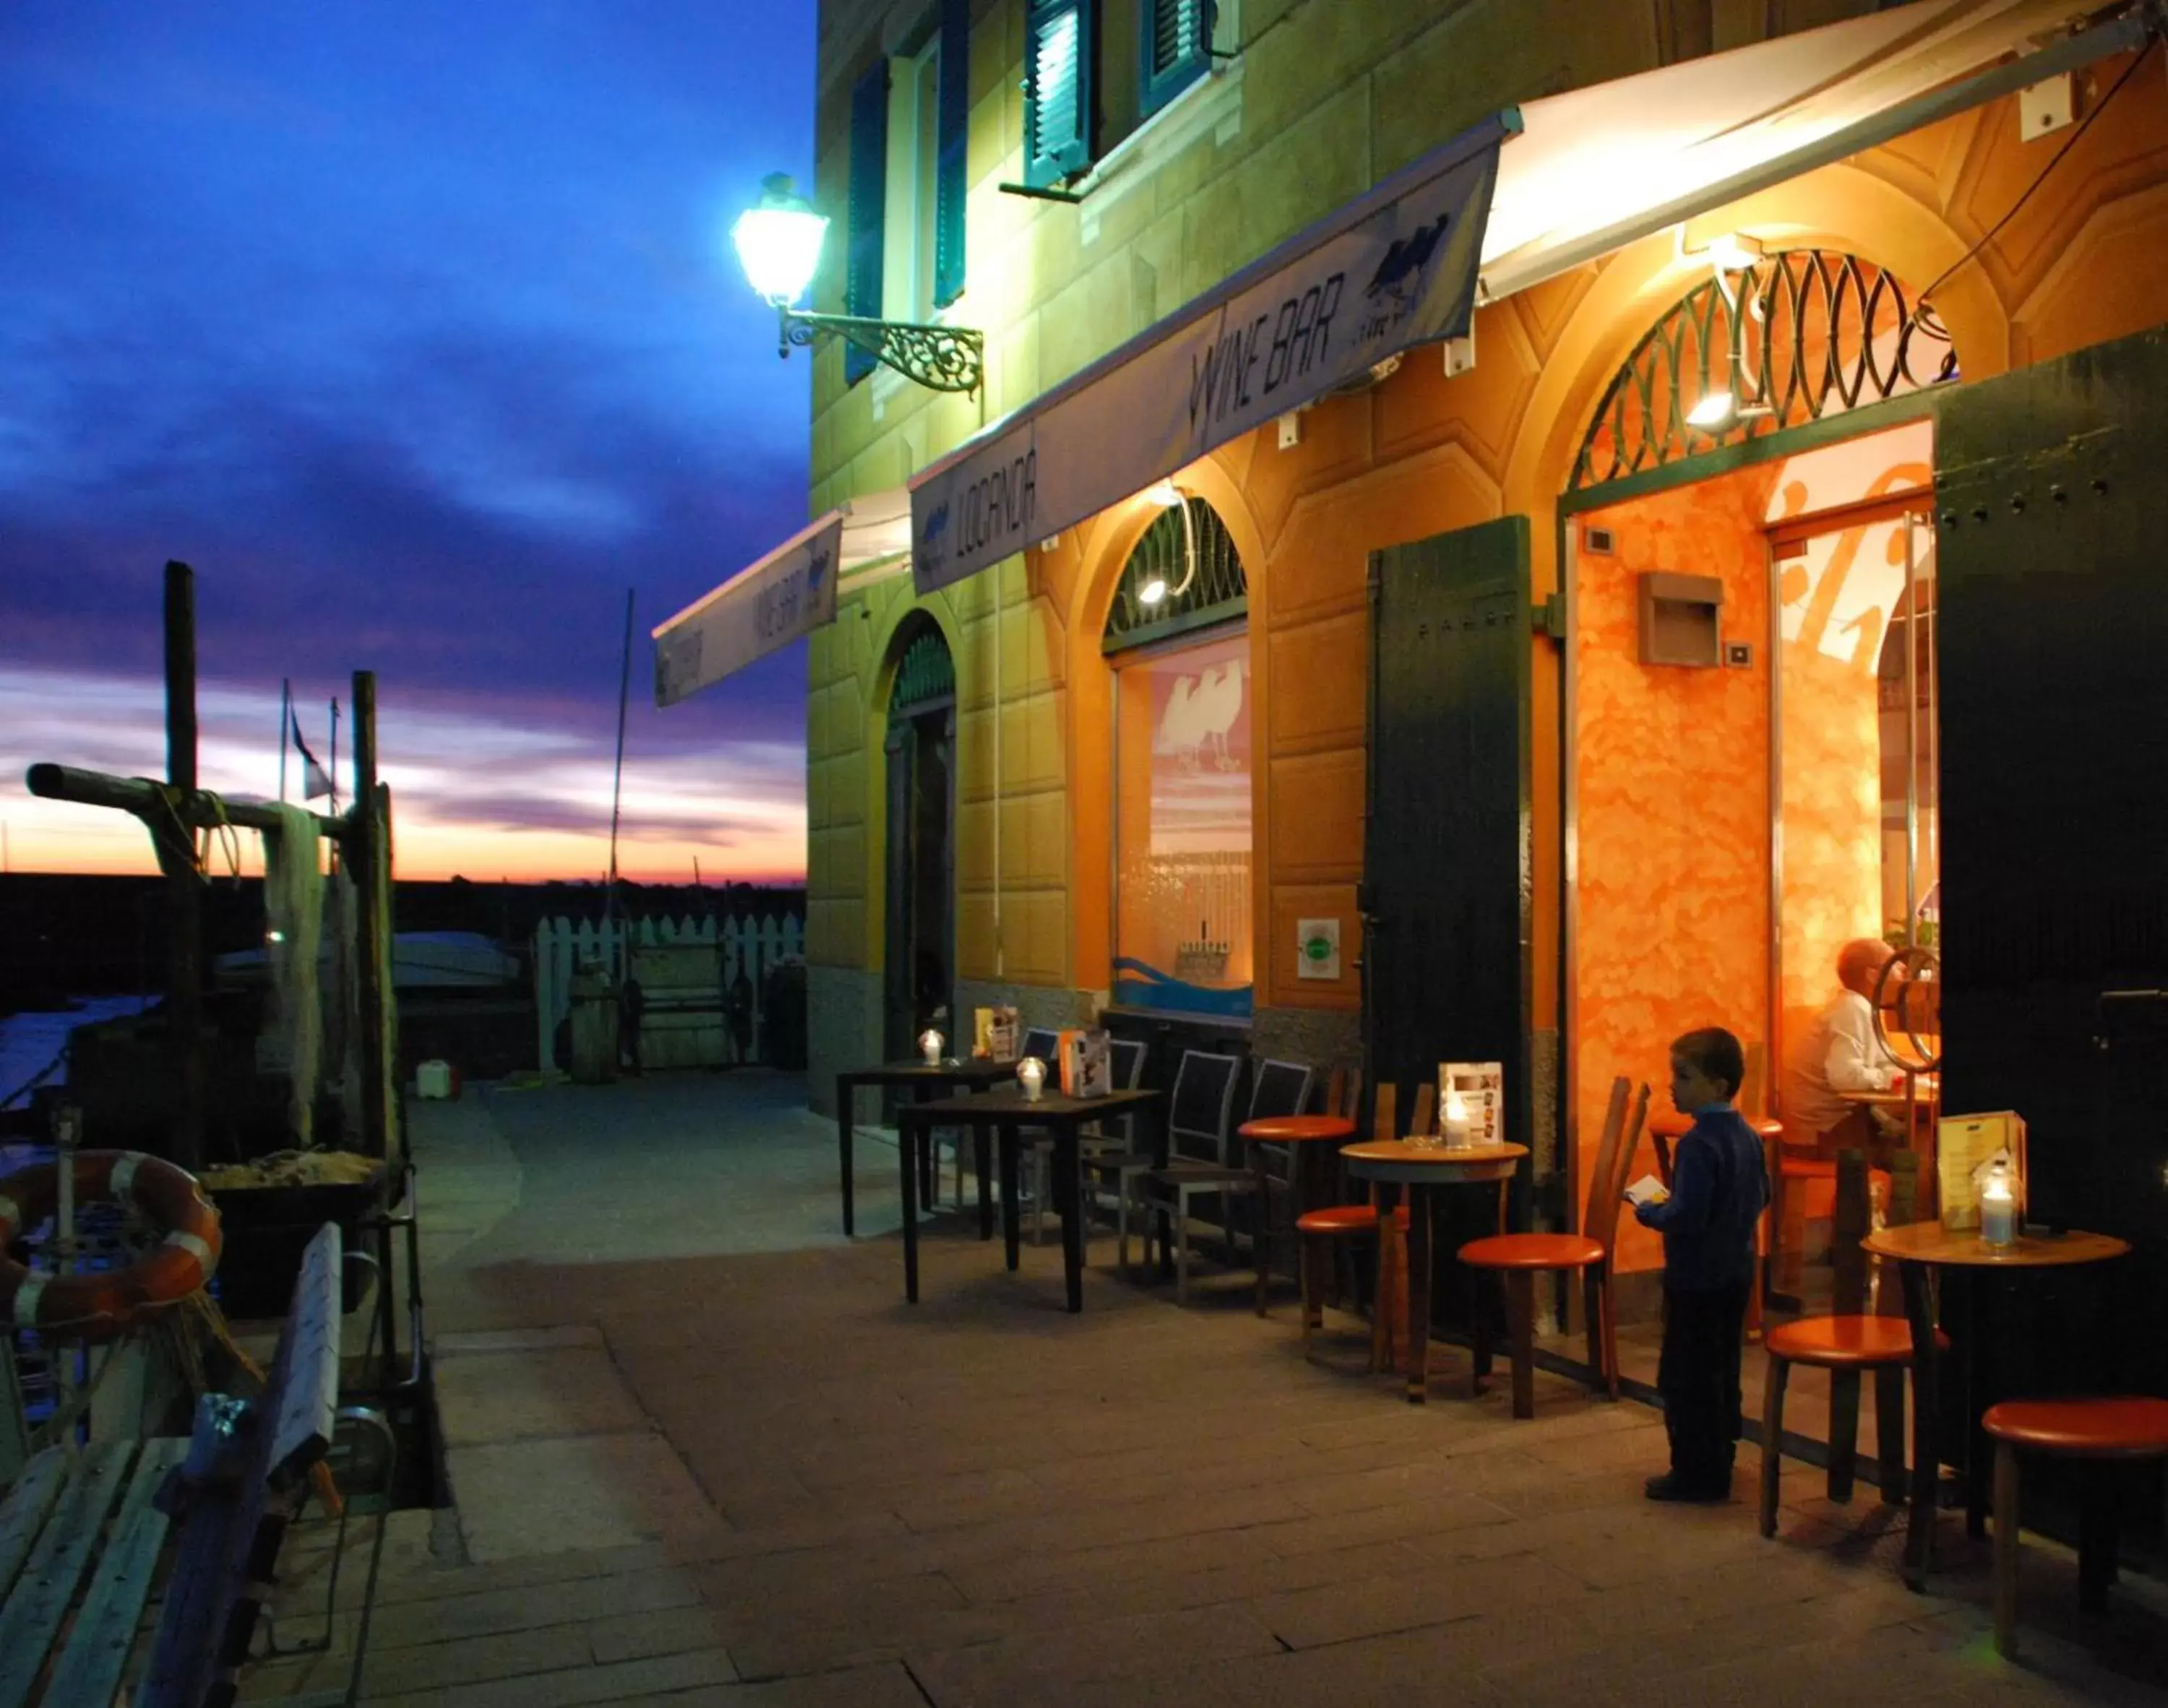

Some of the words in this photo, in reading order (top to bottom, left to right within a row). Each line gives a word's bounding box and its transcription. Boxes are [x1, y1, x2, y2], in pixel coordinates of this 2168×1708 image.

[1190, 314, 1268, 434] WINE
[1263, 272, 1344, 394] BAR
[957, 449, 1036, 558] LOCANDA
